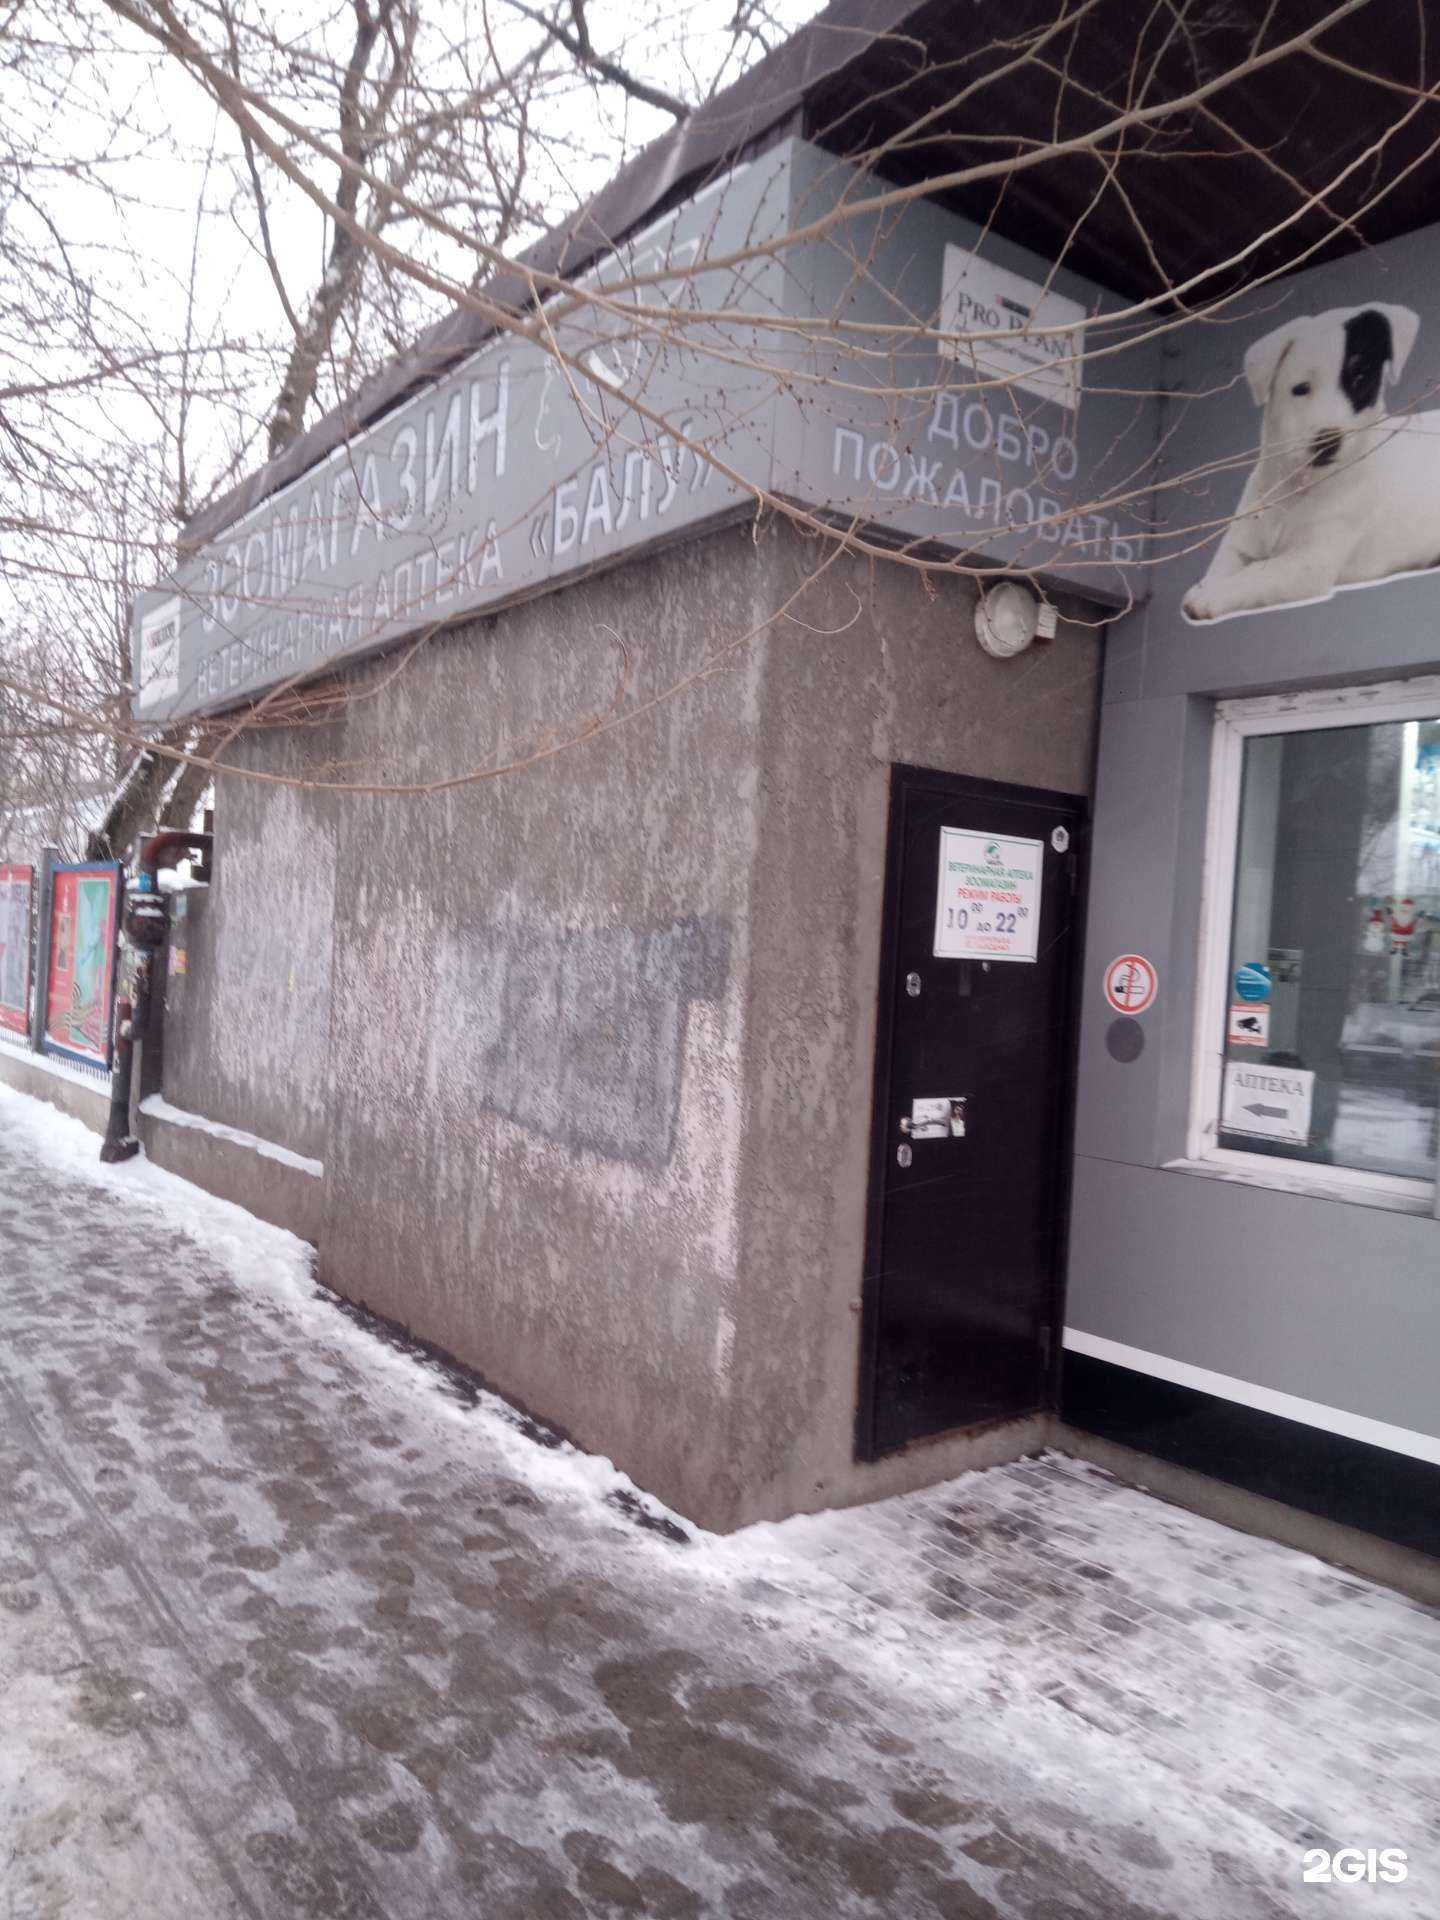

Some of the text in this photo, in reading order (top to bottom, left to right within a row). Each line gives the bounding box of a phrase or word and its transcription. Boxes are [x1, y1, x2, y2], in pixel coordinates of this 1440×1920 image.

[957, 292, 1001, 329] PRO
[927, 392, 1079, 482] ДОБРО
[203, 355, 510, 633] ЗООМАГАЗИН
[373, 519, 503, 633] АПТЕКА
[995, 912, 1017, 933] 22
[1232, 1072, 1305, 1097] АПТЕКА
